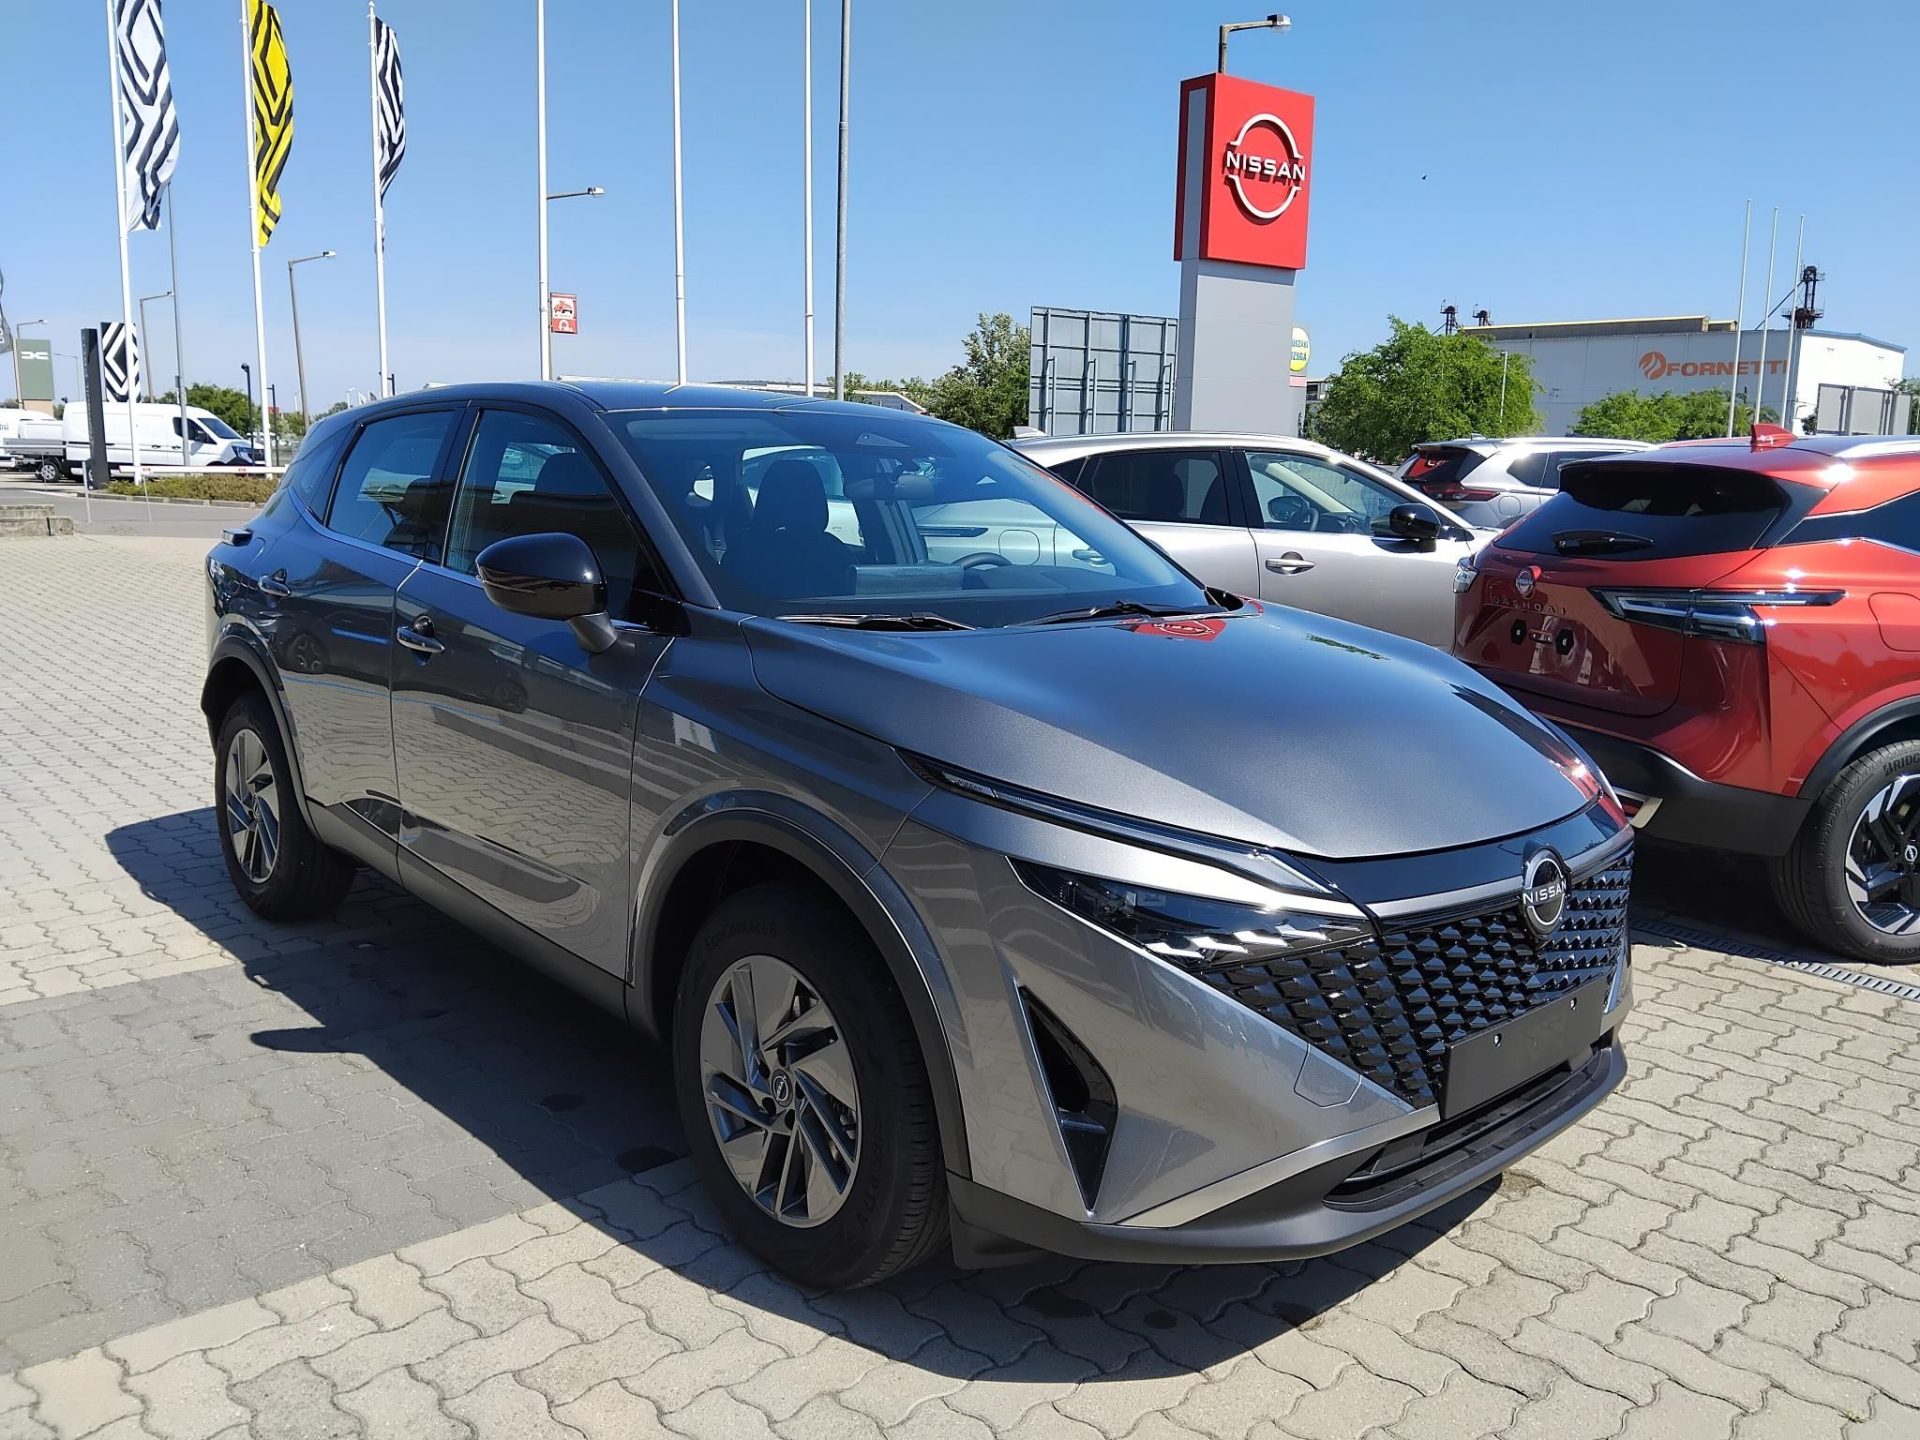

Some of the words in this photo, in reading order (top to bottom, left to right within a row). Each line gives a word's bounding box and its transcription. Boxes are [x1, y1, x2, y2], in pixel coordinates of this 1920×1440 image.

[1226, 151, 1306, 181] NISSAN
[1666, 360, 1789, 377] FORNETTI
[1492, 596, 1567, 615] QASHQAI
[1522, 879, 1567, 905] NISSAN
